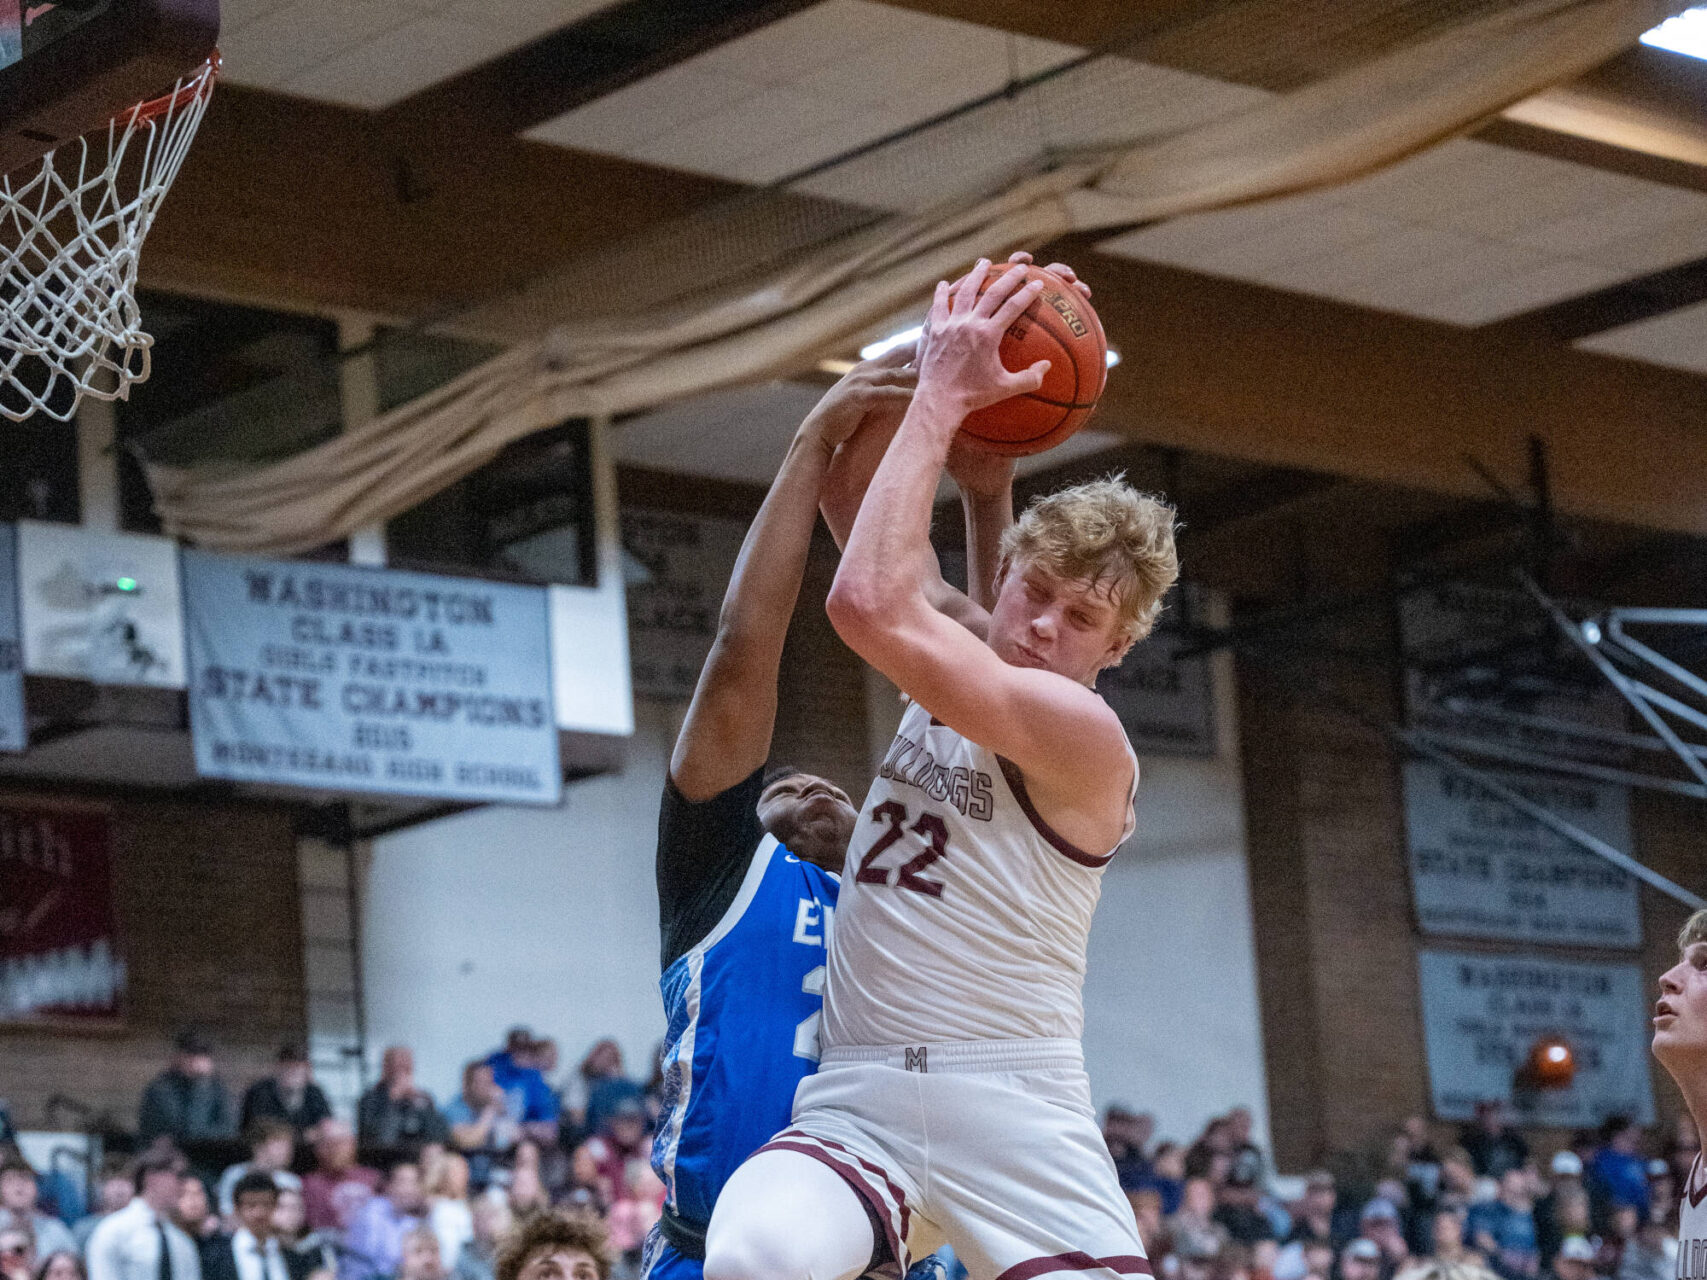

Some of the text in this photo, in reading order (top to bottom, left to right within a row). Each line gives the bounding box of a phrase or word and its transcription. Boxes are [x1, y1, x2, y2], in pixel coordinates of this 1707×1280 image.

[244, 569, 494, 625] WASHINGTON
[291, 615, 399, 650] CLASS
[202, 665, 546, 728] STATE CHAMPIONS
[855, 797, 951, 899] 22
[905, 1046, 928, 1074] M
